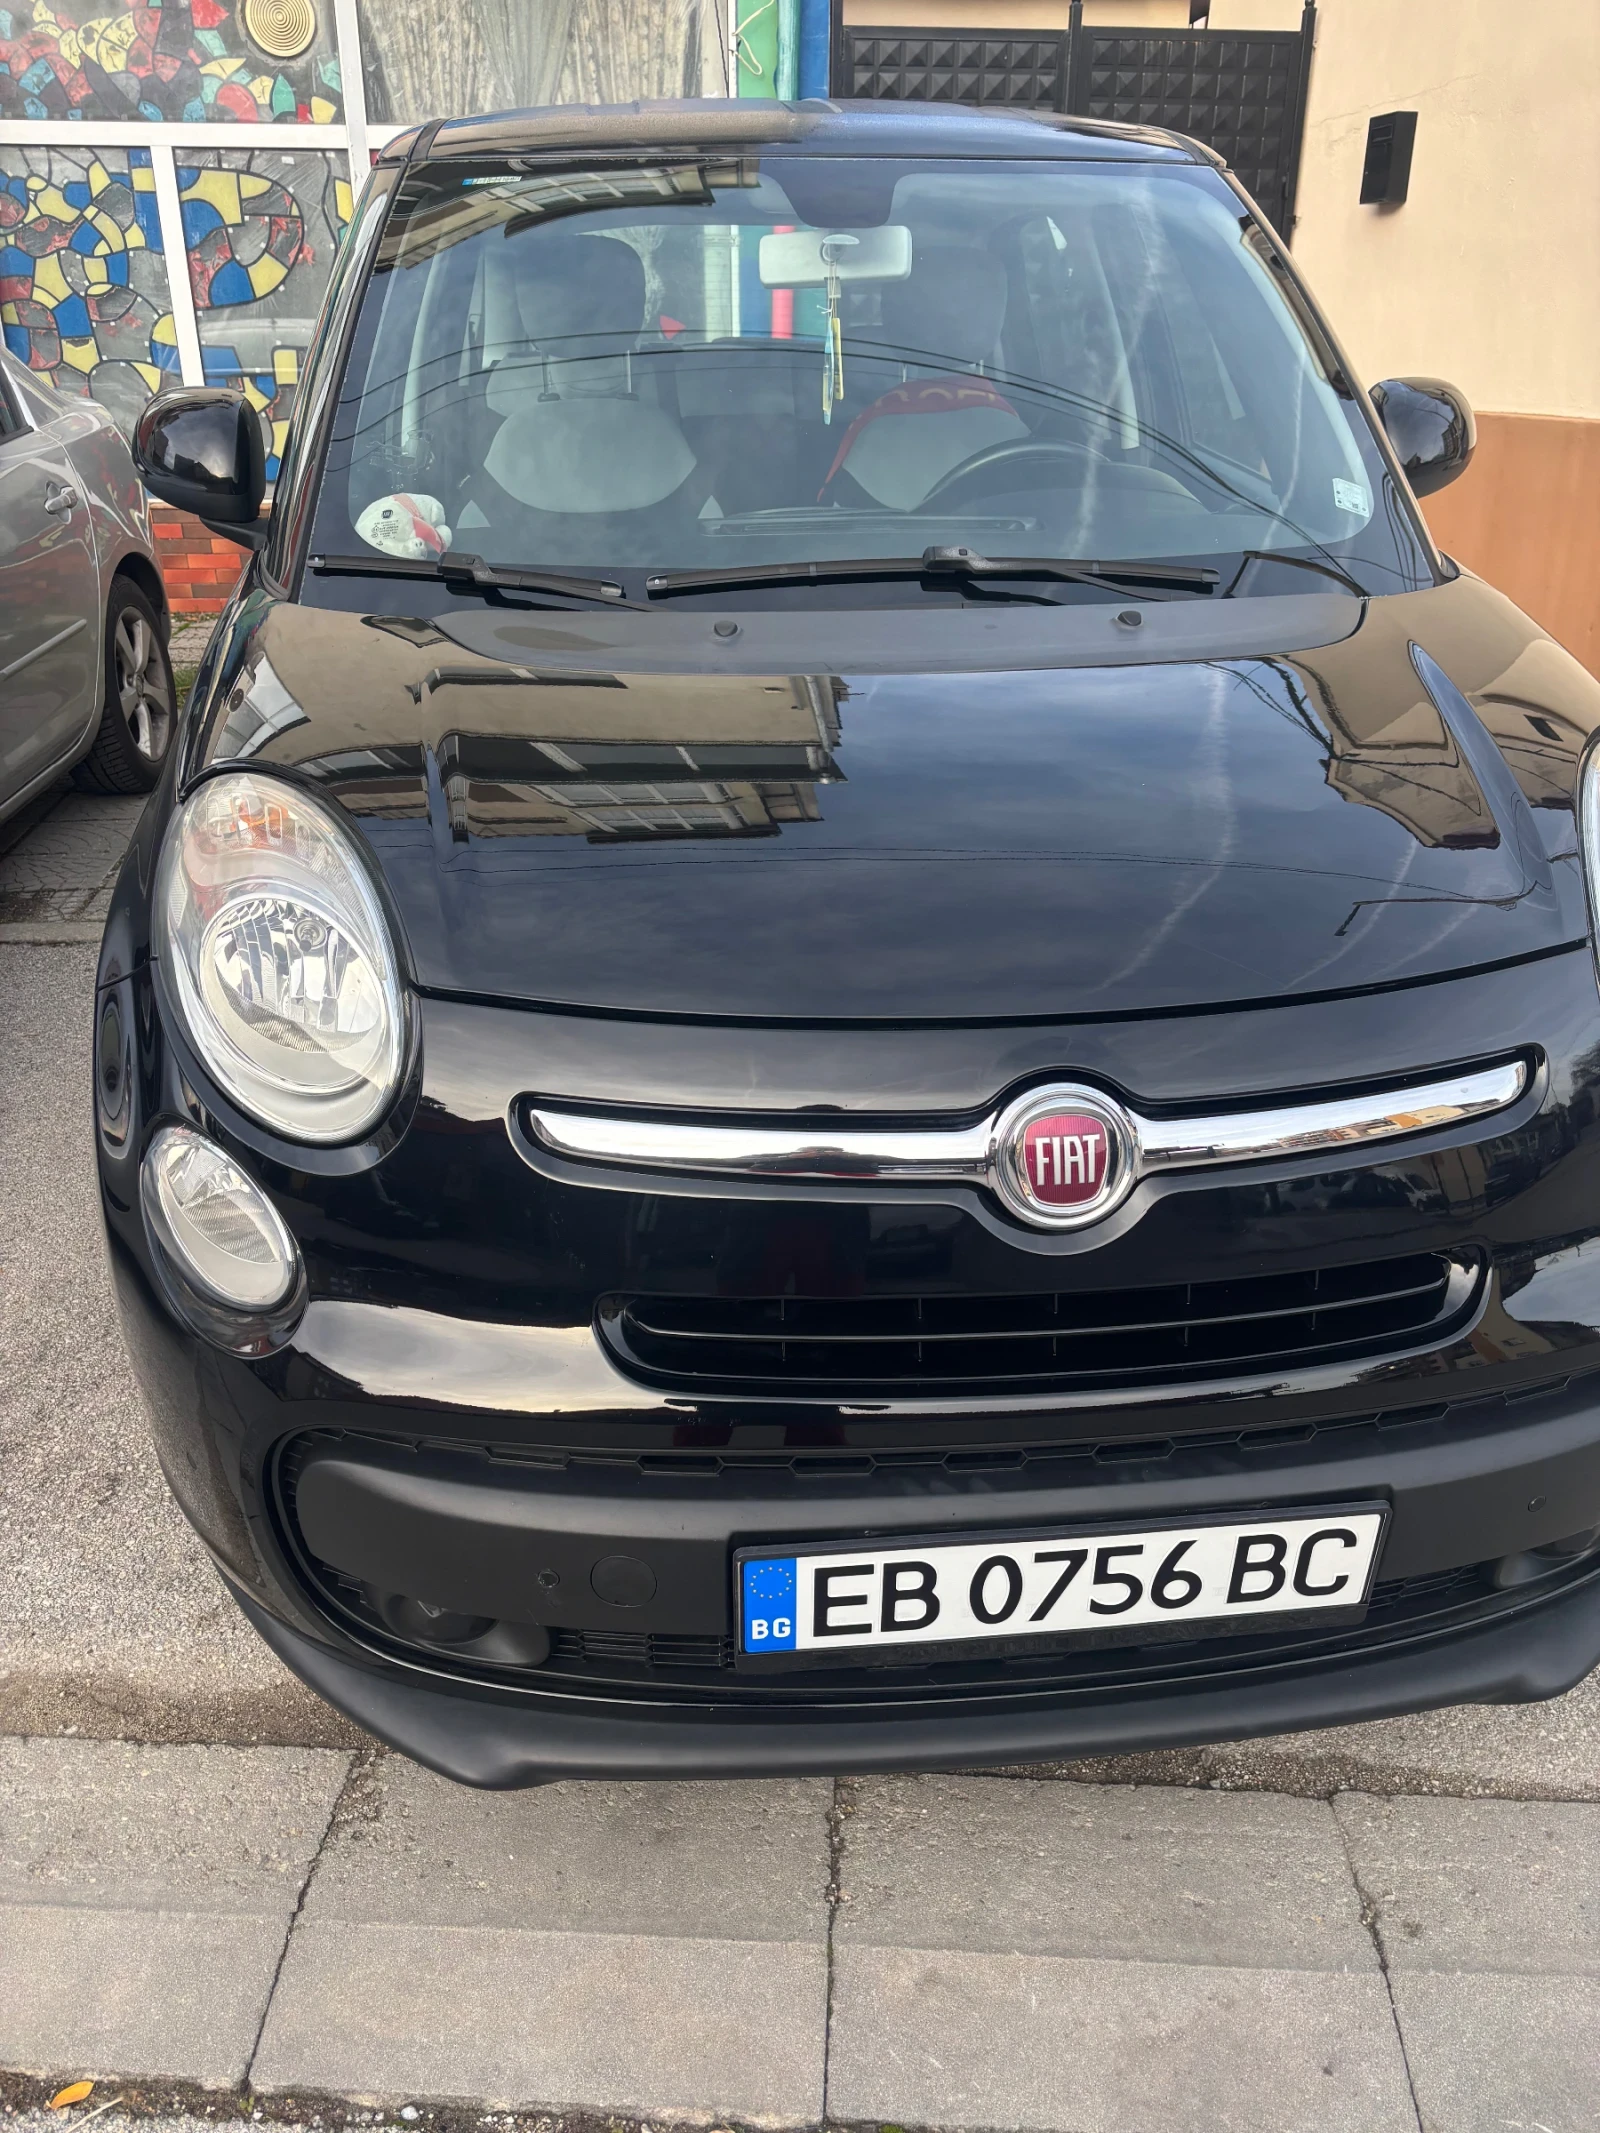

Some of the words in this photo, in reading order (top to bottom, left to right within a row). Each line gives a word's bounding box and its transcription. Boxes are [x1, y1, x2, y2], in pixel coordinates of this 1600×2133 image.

[1035, 1134, 1100, 1186] FIAT
[813, 1561, 941, 1638] EB
[969, 1539, 1203, 1624] 0756
[1226, 1528, 1357, 1604] BC
[751, 1618, 791, 1639] BG
